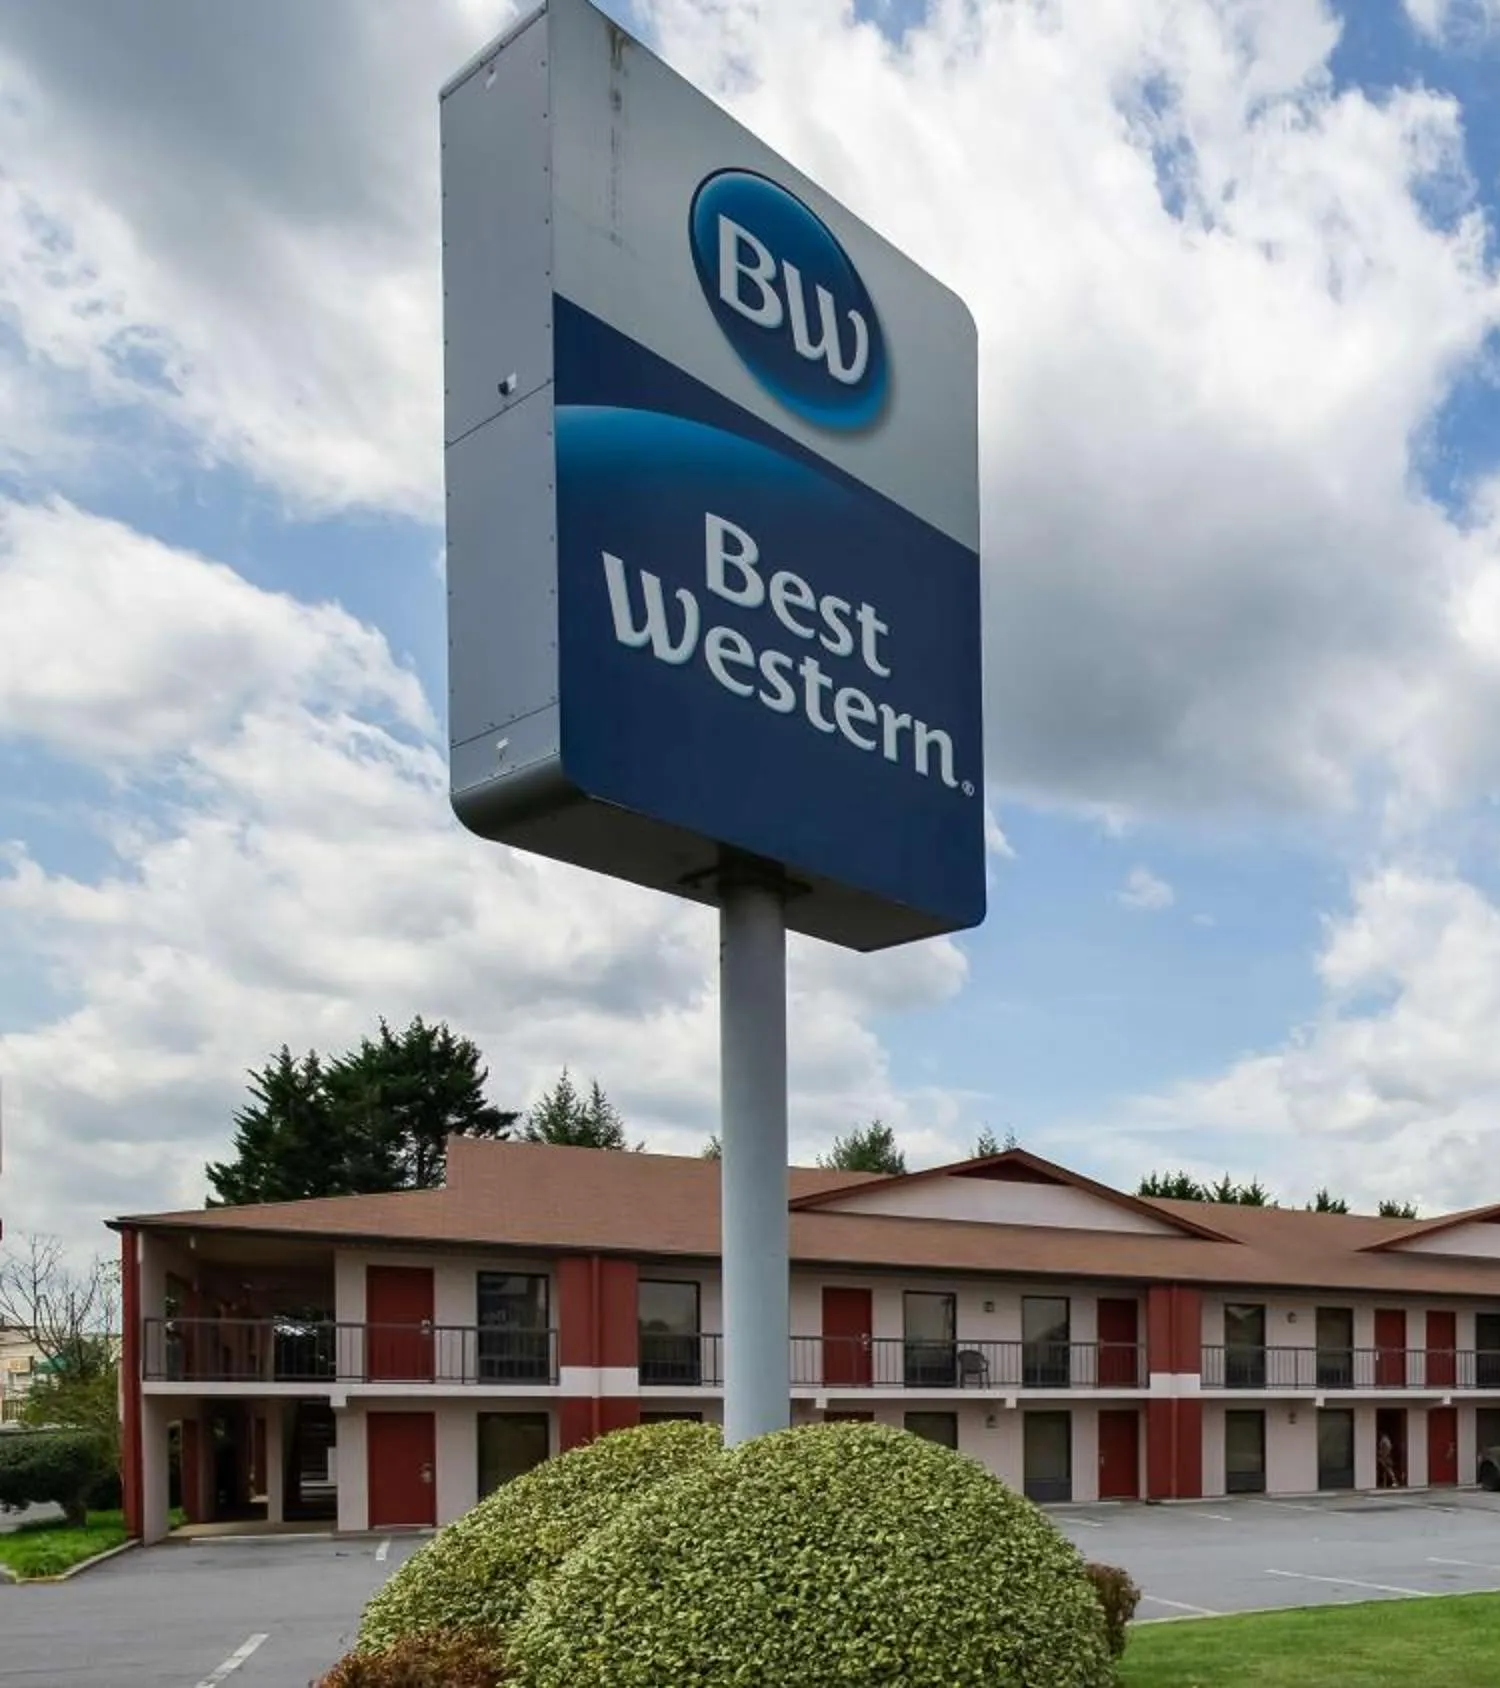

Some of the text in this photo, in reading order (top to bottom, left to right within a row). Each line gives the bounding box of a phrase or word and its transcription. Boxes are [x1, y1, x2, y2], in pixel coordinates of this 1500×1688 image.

[719, 213, 869, 385] BW
[602, 550, 959, 788] Western
[705, 511, 891, 678] Best
